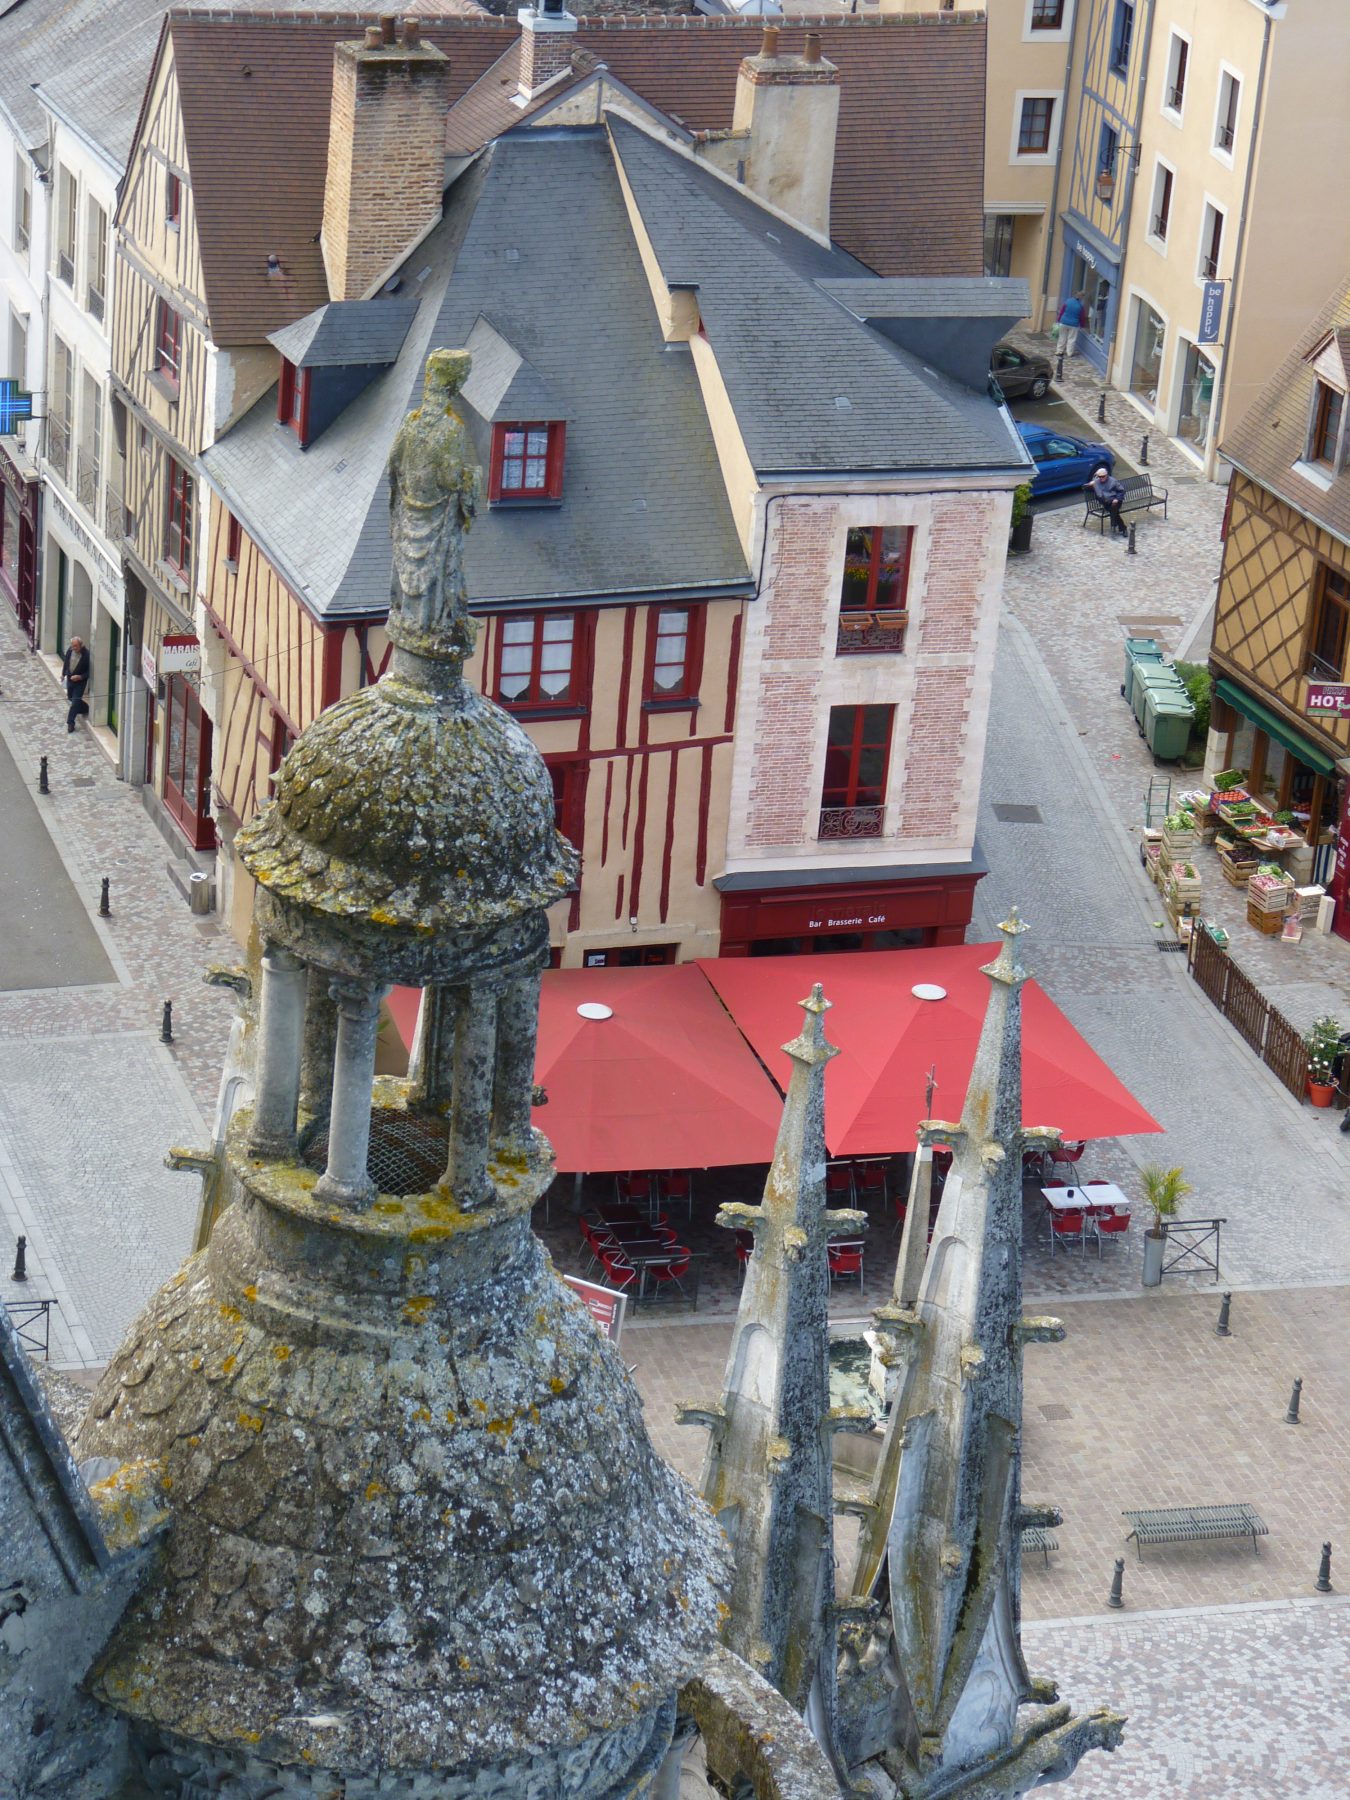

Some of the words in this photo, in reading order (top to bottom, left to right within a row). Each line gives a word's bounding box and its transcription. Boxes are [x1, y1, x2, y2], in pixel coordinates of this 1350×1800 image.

[1209, 287, 1221, 296] be
[1205, 297, 1214, 335] happy
[53, 491, 118, 589] PHARMACIE
[163, 644, 200, 655] MARAIS
[809, 920, 822, 928] Bar
[828, 917, 862, 927] Brasserie
[868, 915, 885, 924] Café
